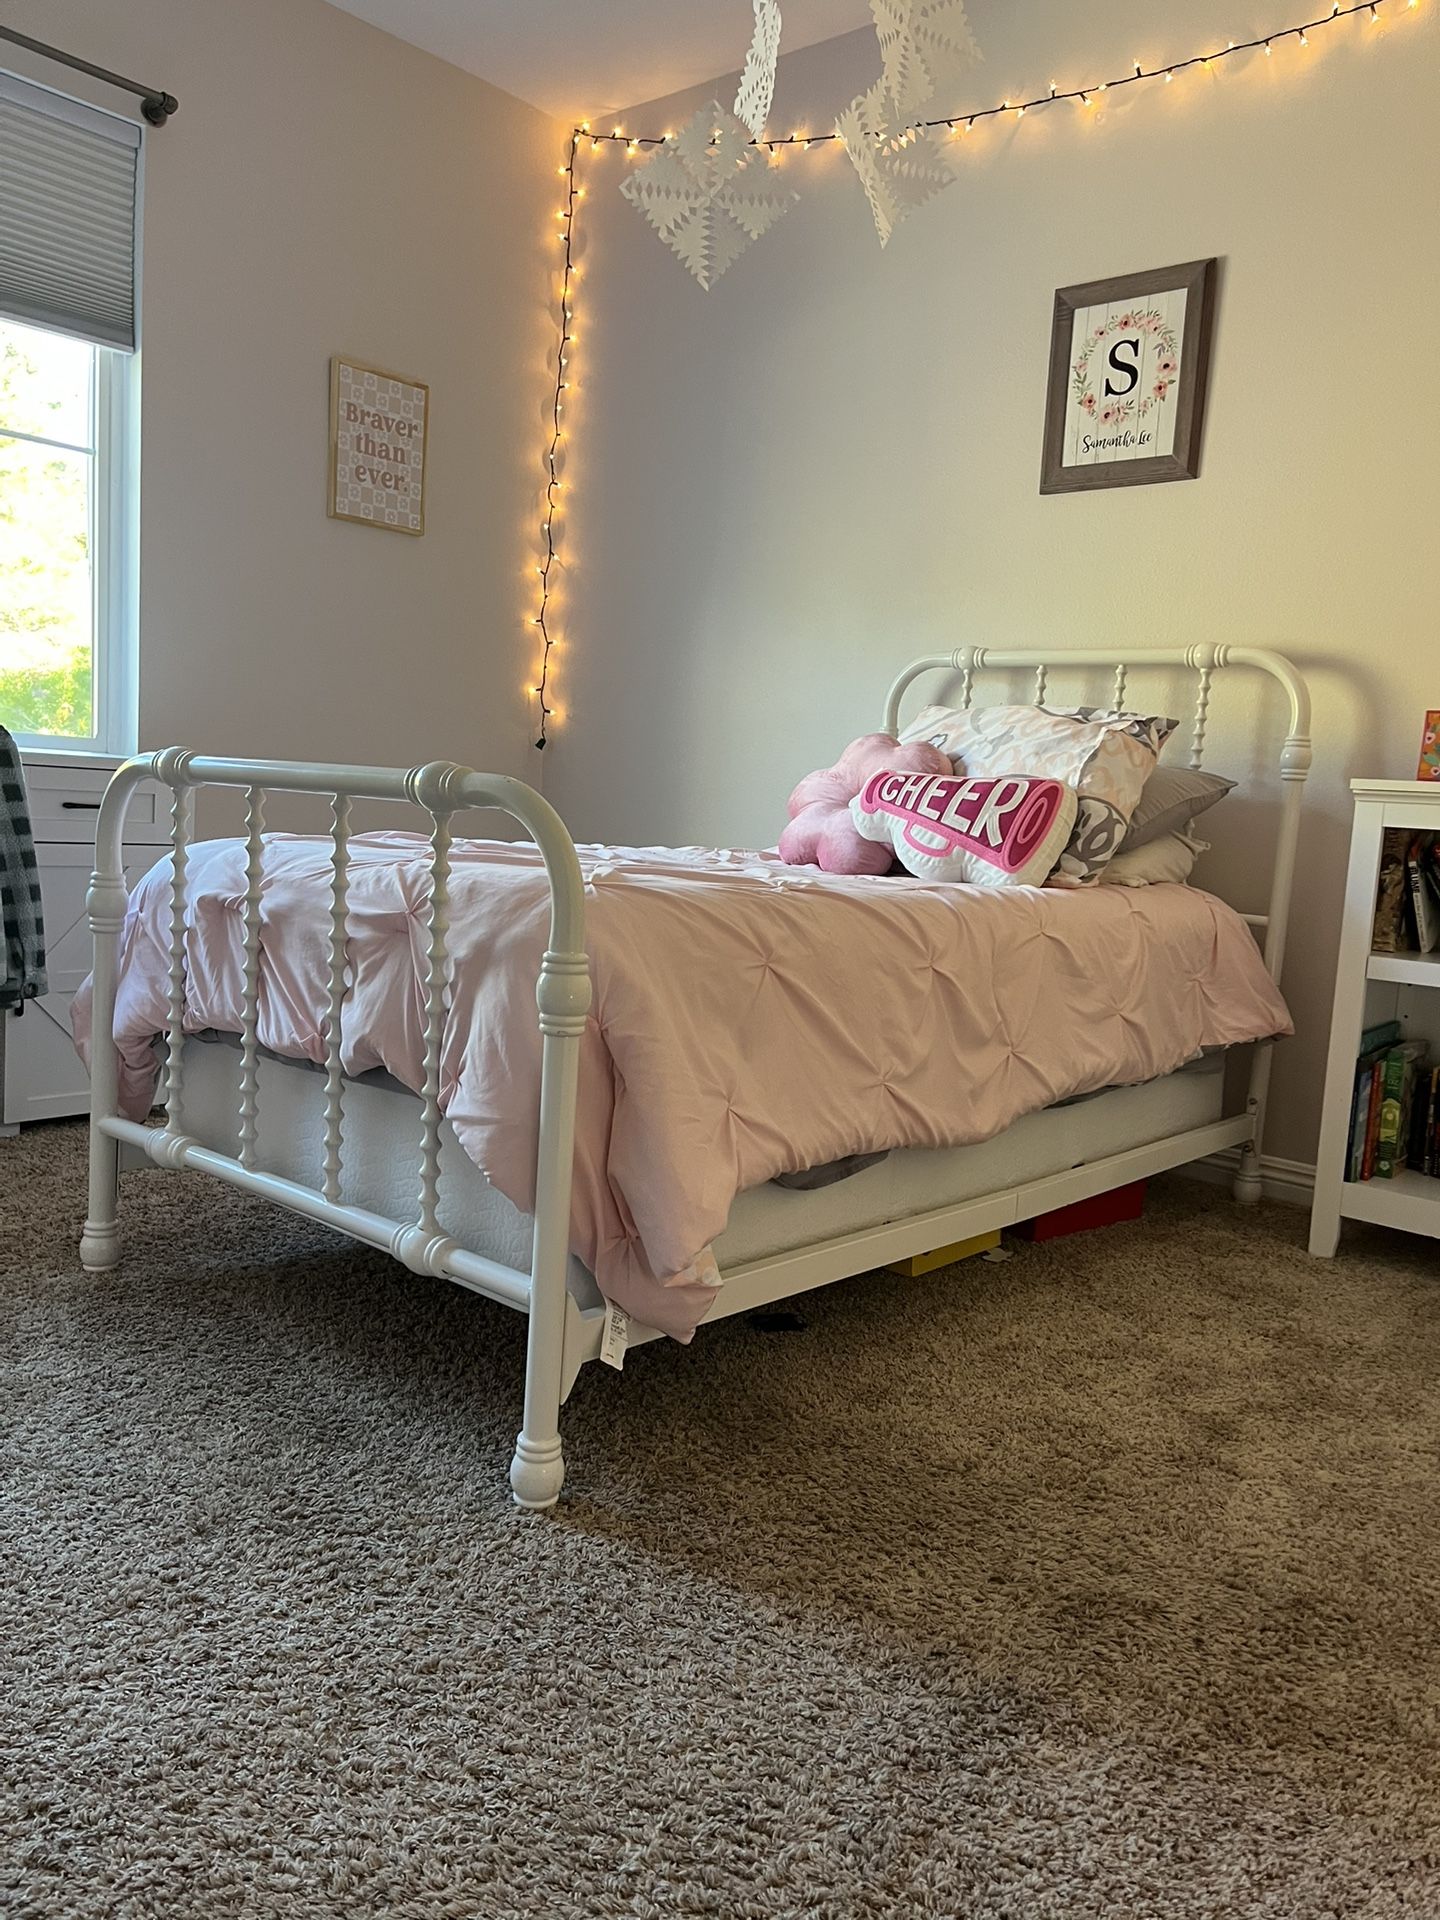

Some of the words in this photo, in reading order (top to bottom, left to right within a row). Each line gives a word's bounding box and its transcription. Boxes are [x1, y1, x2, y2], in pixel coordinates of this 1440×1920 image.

[1104, 338, 1140, 397] S
[346, 401, 418, 440] Braver
[355, 433, 406, 465] than
[1082, 430, 1136, 453] Samantha
[1137, 430, 1153, 445] Lee
[354, 464, 408, 493] ever.
[881, 775, 1029, 847] CHEER
